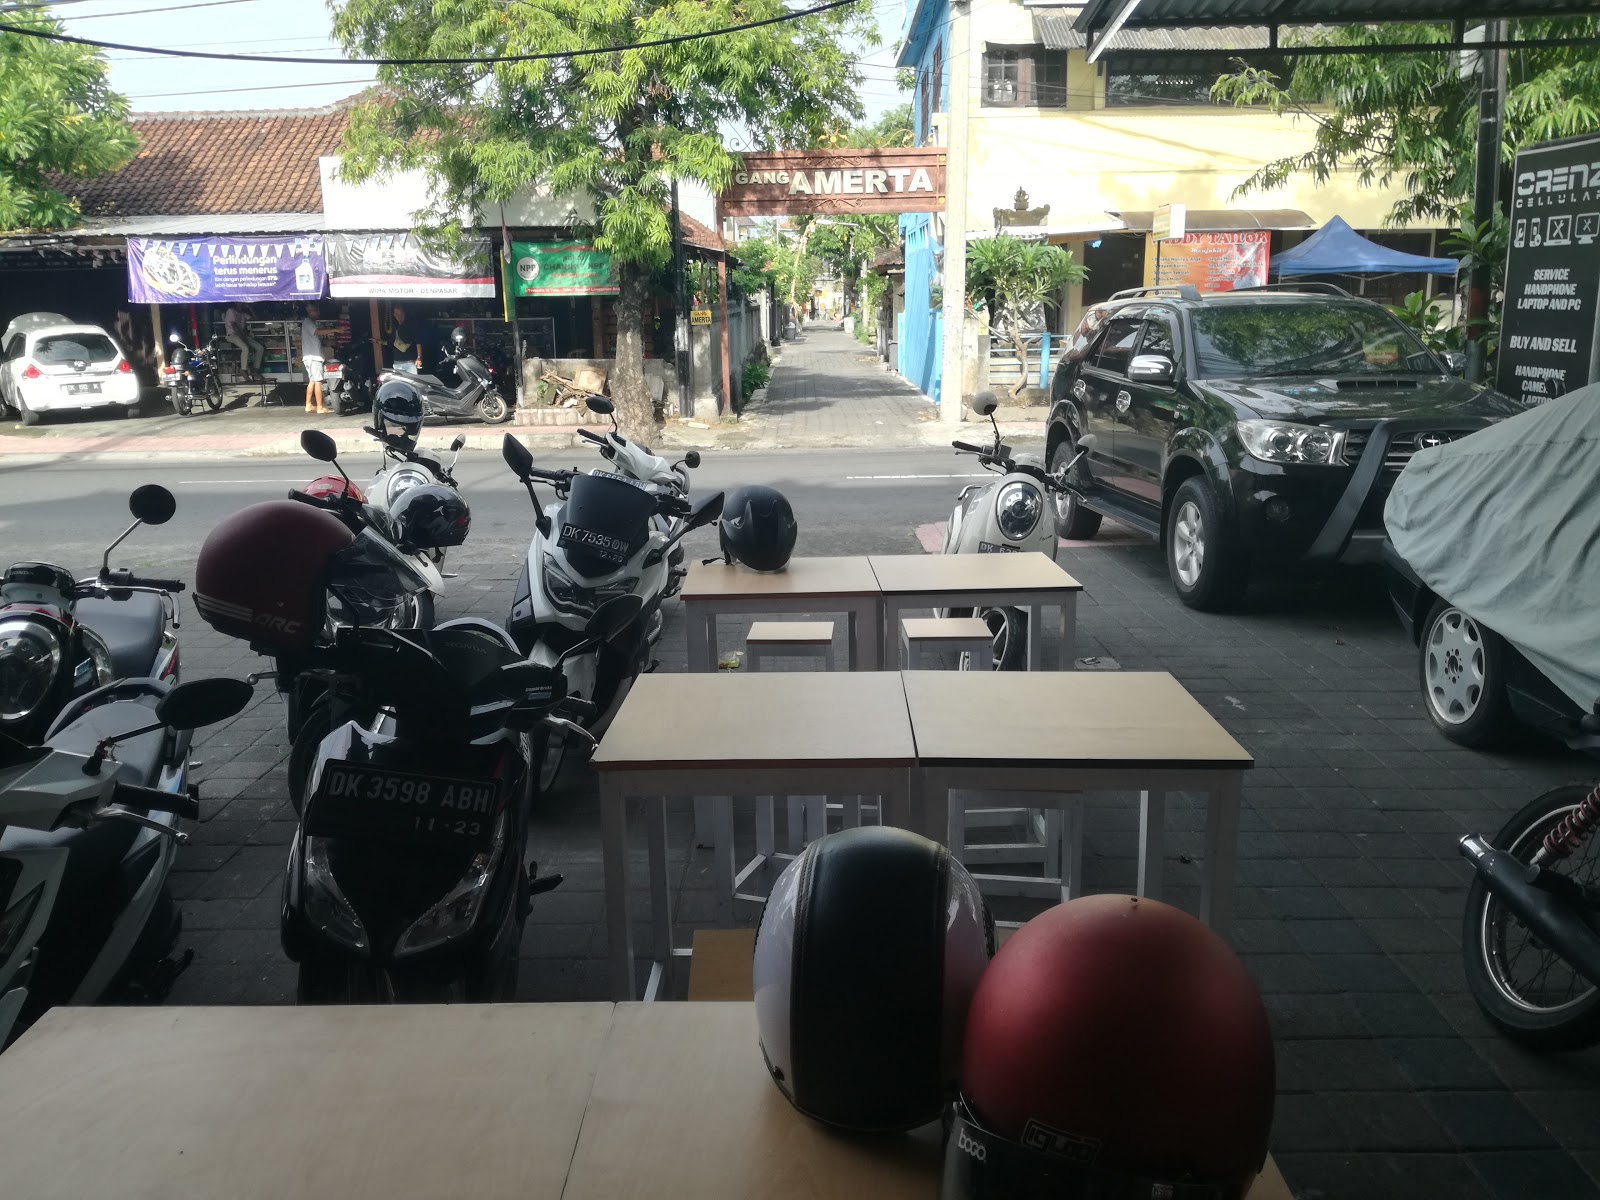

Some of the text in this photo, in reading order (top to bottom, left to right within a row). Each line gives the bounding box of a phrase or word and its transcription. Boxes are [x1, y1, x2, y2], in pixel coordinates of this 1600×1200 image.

[735, 168, 934, 195] GANG AMERTA
[1208, 231, 1268, 244] TAILOR
[213, 255, 277, 267] Perlindungan
[214, 267, 278, 275] terus menerus
[520, 264, 536, 272] NPP
[1533, 269, 1570, 281] SERVICE
[1524, 283, 1577, 295] HANDPHONE
[1517, 298, 1581, 311] LAPTOP AND PC
[691, 316, 712, 324] AMERTA
[1510, 335, 1577, 353] BUY AND SELL
[1515, 365, 1567, 381] HANDPHONE
[1522, 380, 1549, 394] CAME
[562, 525, 581, 540] DK
[582, 530, 612, 549] 7535
[981, 543, 994, 553] DK
[329, 771, 491, 812] DK 3598 ABH
